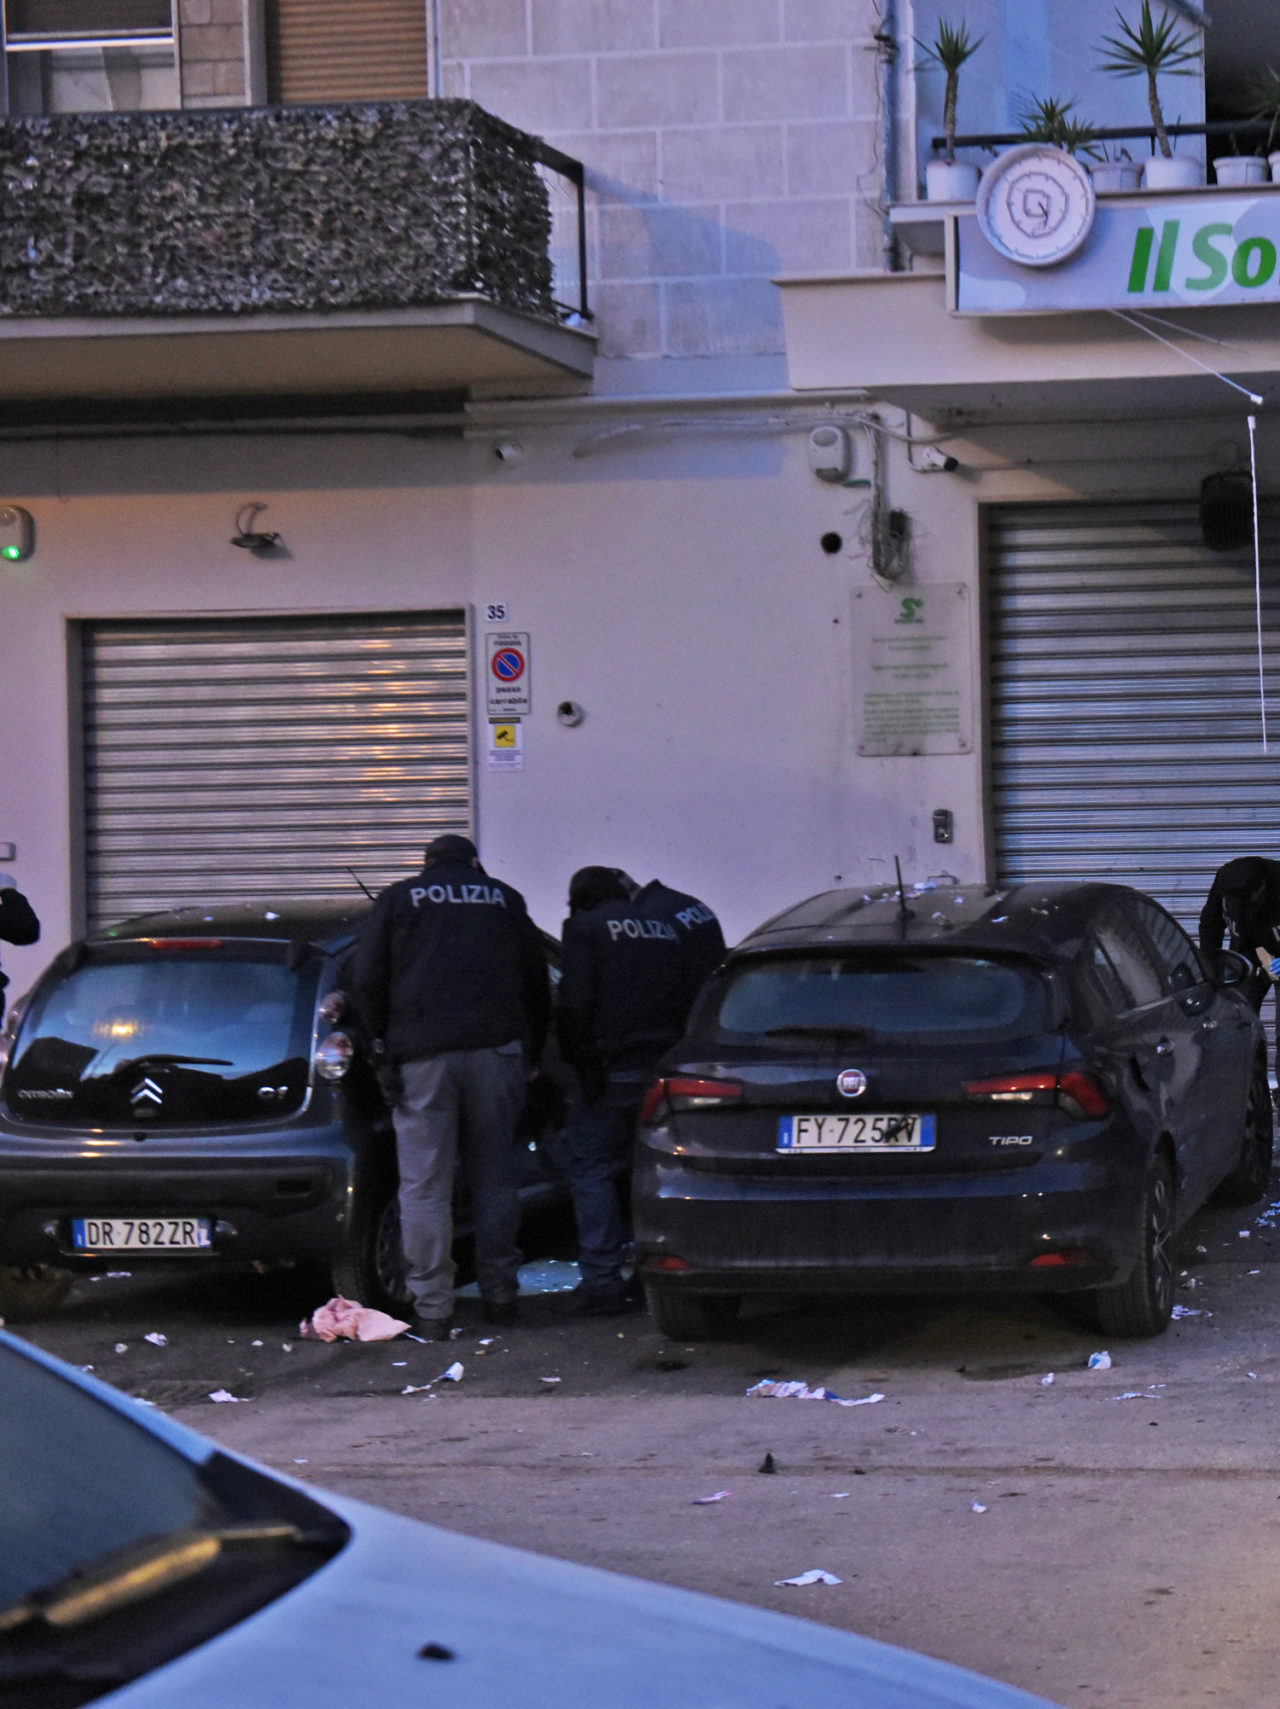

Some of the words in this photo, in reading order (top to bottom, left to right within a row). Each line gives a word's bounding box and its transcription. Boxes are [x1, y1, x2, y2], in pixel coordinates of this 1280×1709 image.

[1127, 219, 1181, 293] Il
[487, 604, 505, 620] 35
[410, 885, 506, 908] POLIZIA
[988, 1135, 1033, 1146] TIPO
